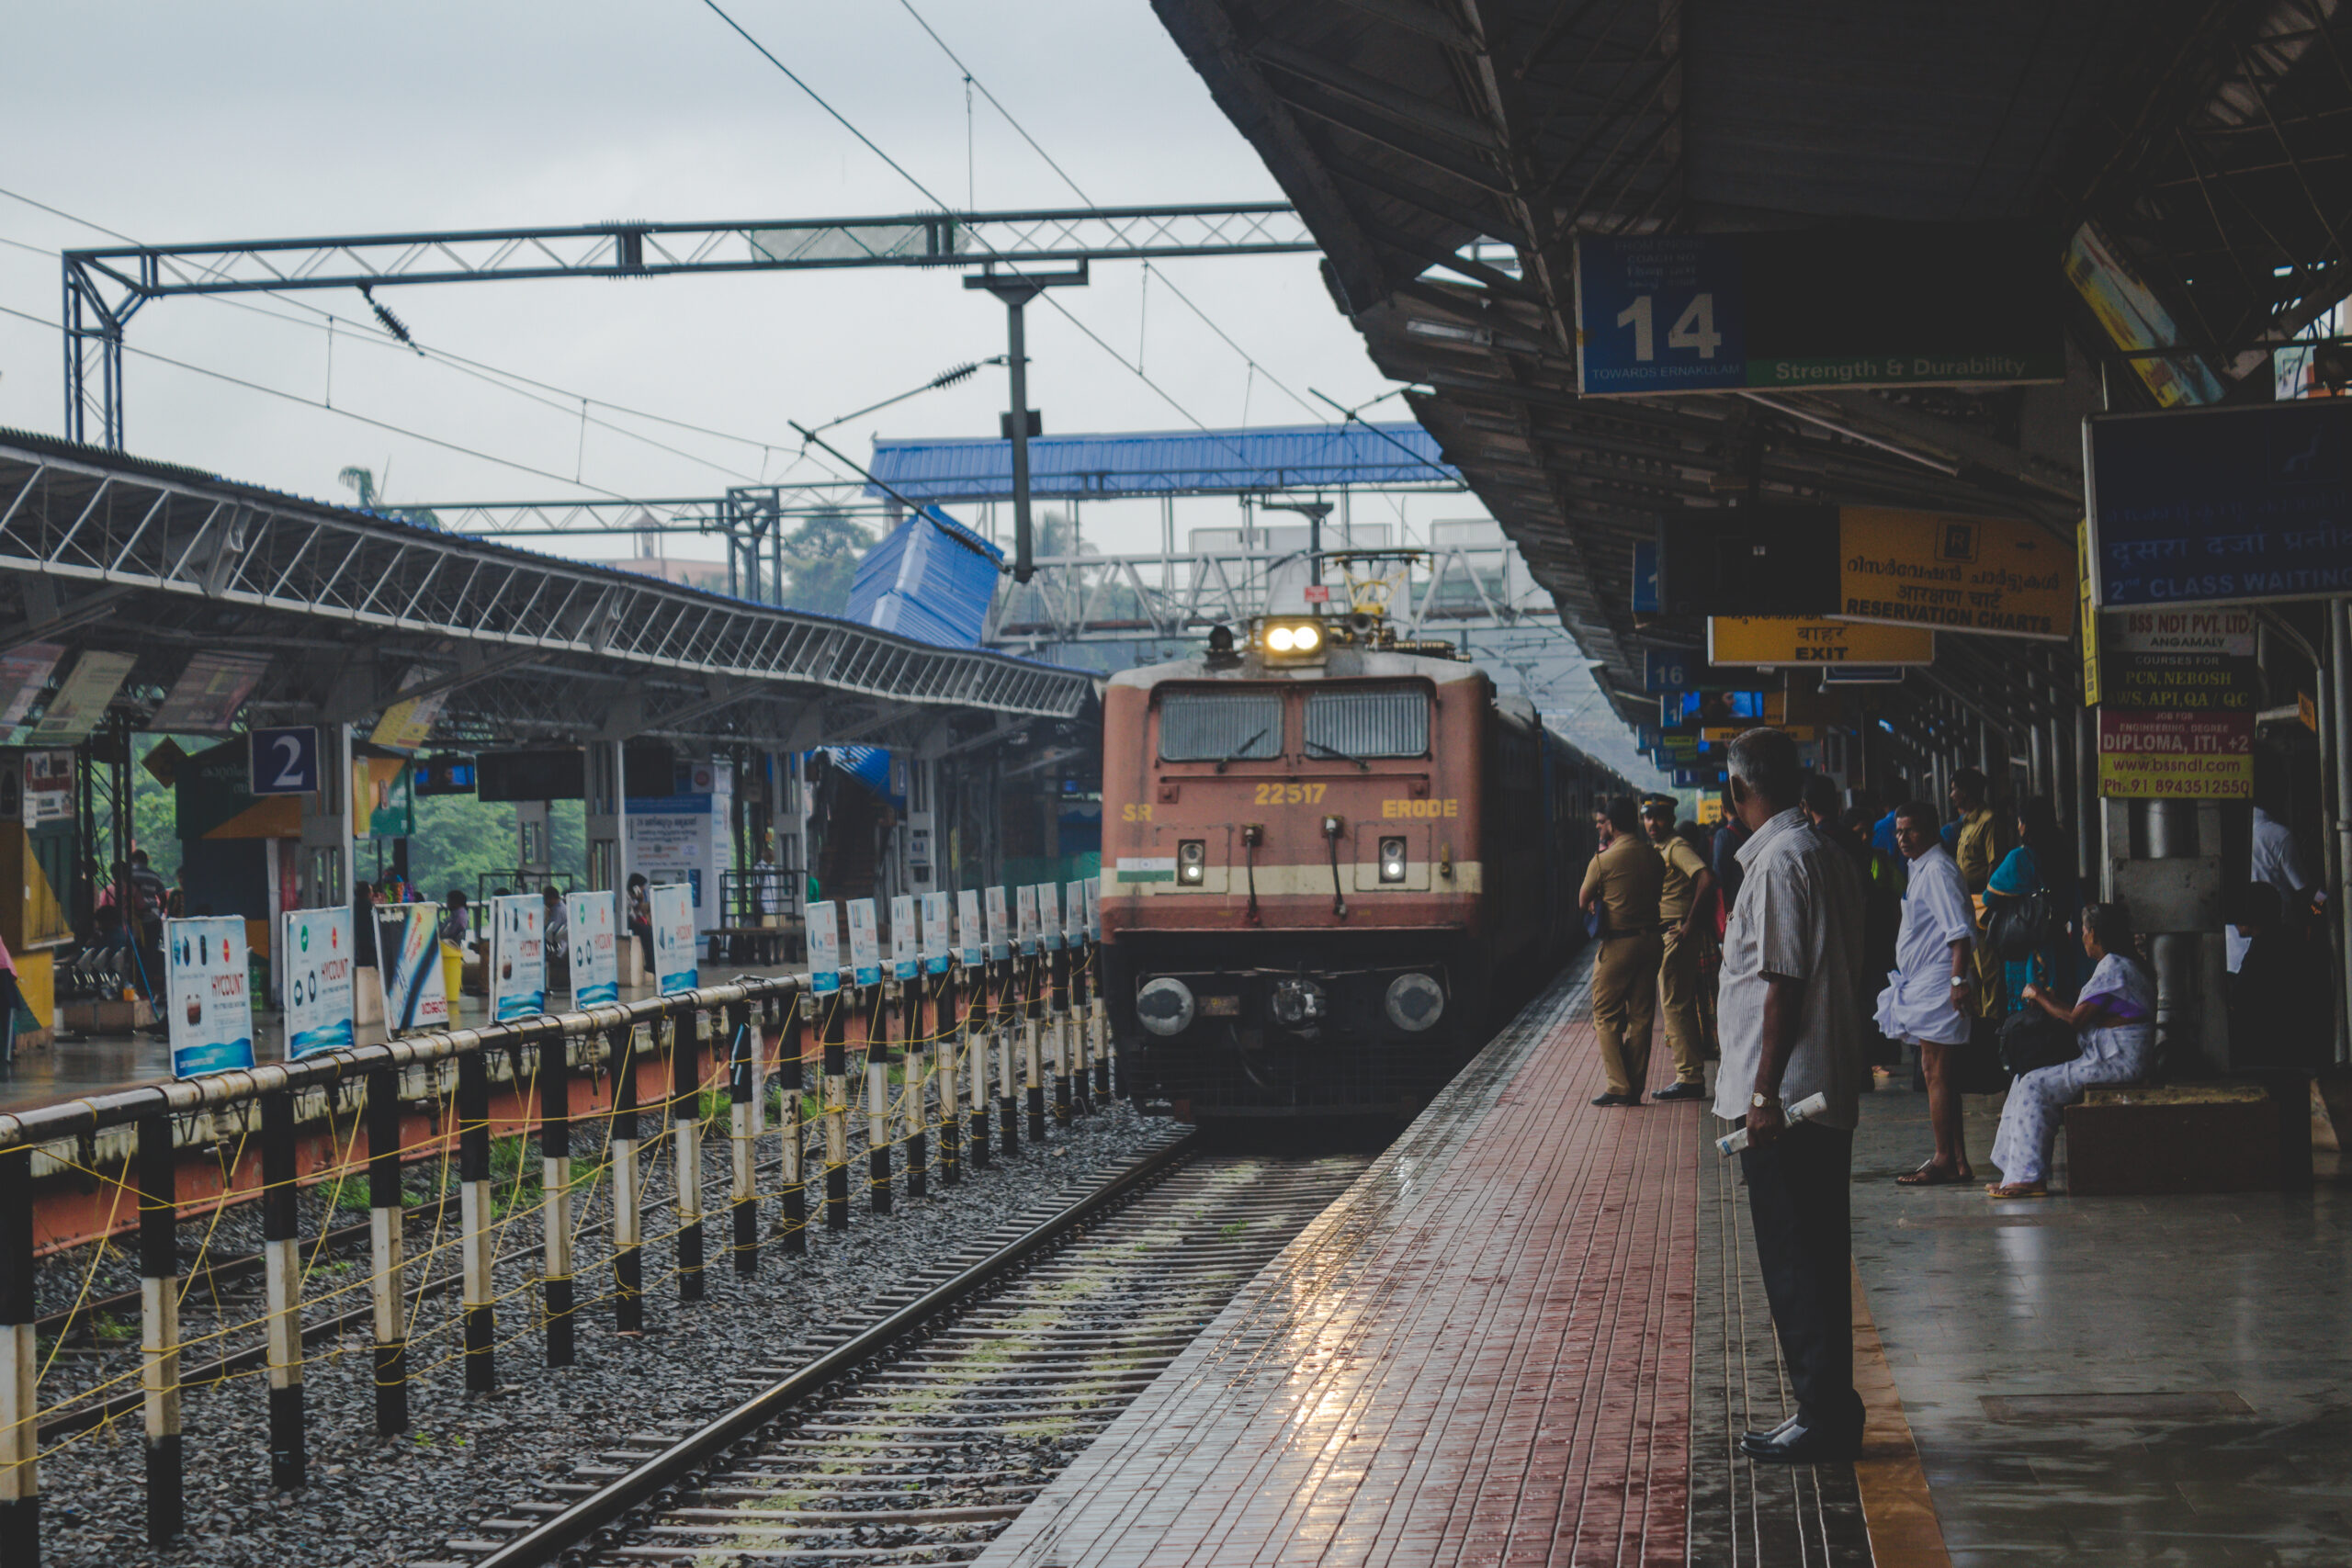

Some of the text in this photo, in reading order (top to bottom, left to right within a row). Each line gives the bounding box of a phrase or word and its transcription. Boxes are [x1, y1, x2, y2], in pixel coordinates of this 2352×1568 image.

[1616, 292, 1722, 361] 14
[1591, 364, 1739, 381] TOWARDS ERNAKULAM
[1775, 356, 2027, 382] Strength & Durability
[2149, 572, 2235, 599] CLASS
[1846, 598, 1972, 626] RESERVATION
[1977, 611, 2052, 635] CHARTS
[2129, 614, 2253, 634] BSS NDT PVT. LTD.
[1796, 626, 1848, 643] बाहर
[2150, 637, 2225, 648] ANGAMALY
[1795, 646, 1849, 661] EXIT
[2134, 655, 2220, 666] COURSES FOR
[1655, 664, 1684, 685] 16
[2222, 692, 2249, 708] QC
[2155, 712, 2194, 720] JOB FOR
[2190, 724, 2230, 733] DEGREE
[2103, 734, 2249, 754] DIPLOMA, ITI, +2
[271, 734, 304, 786] 2
[2113, 759, 2241, 773] www.bssndt.com
[1254, 783, 1328, 806] 22517
[2131, 779, 2148, 794] 91
[2155, 779, 2250, 795] 8943512550
[1121, 803, 1152, 822] SR
[1383, 798, 1458, 818] ERODE
